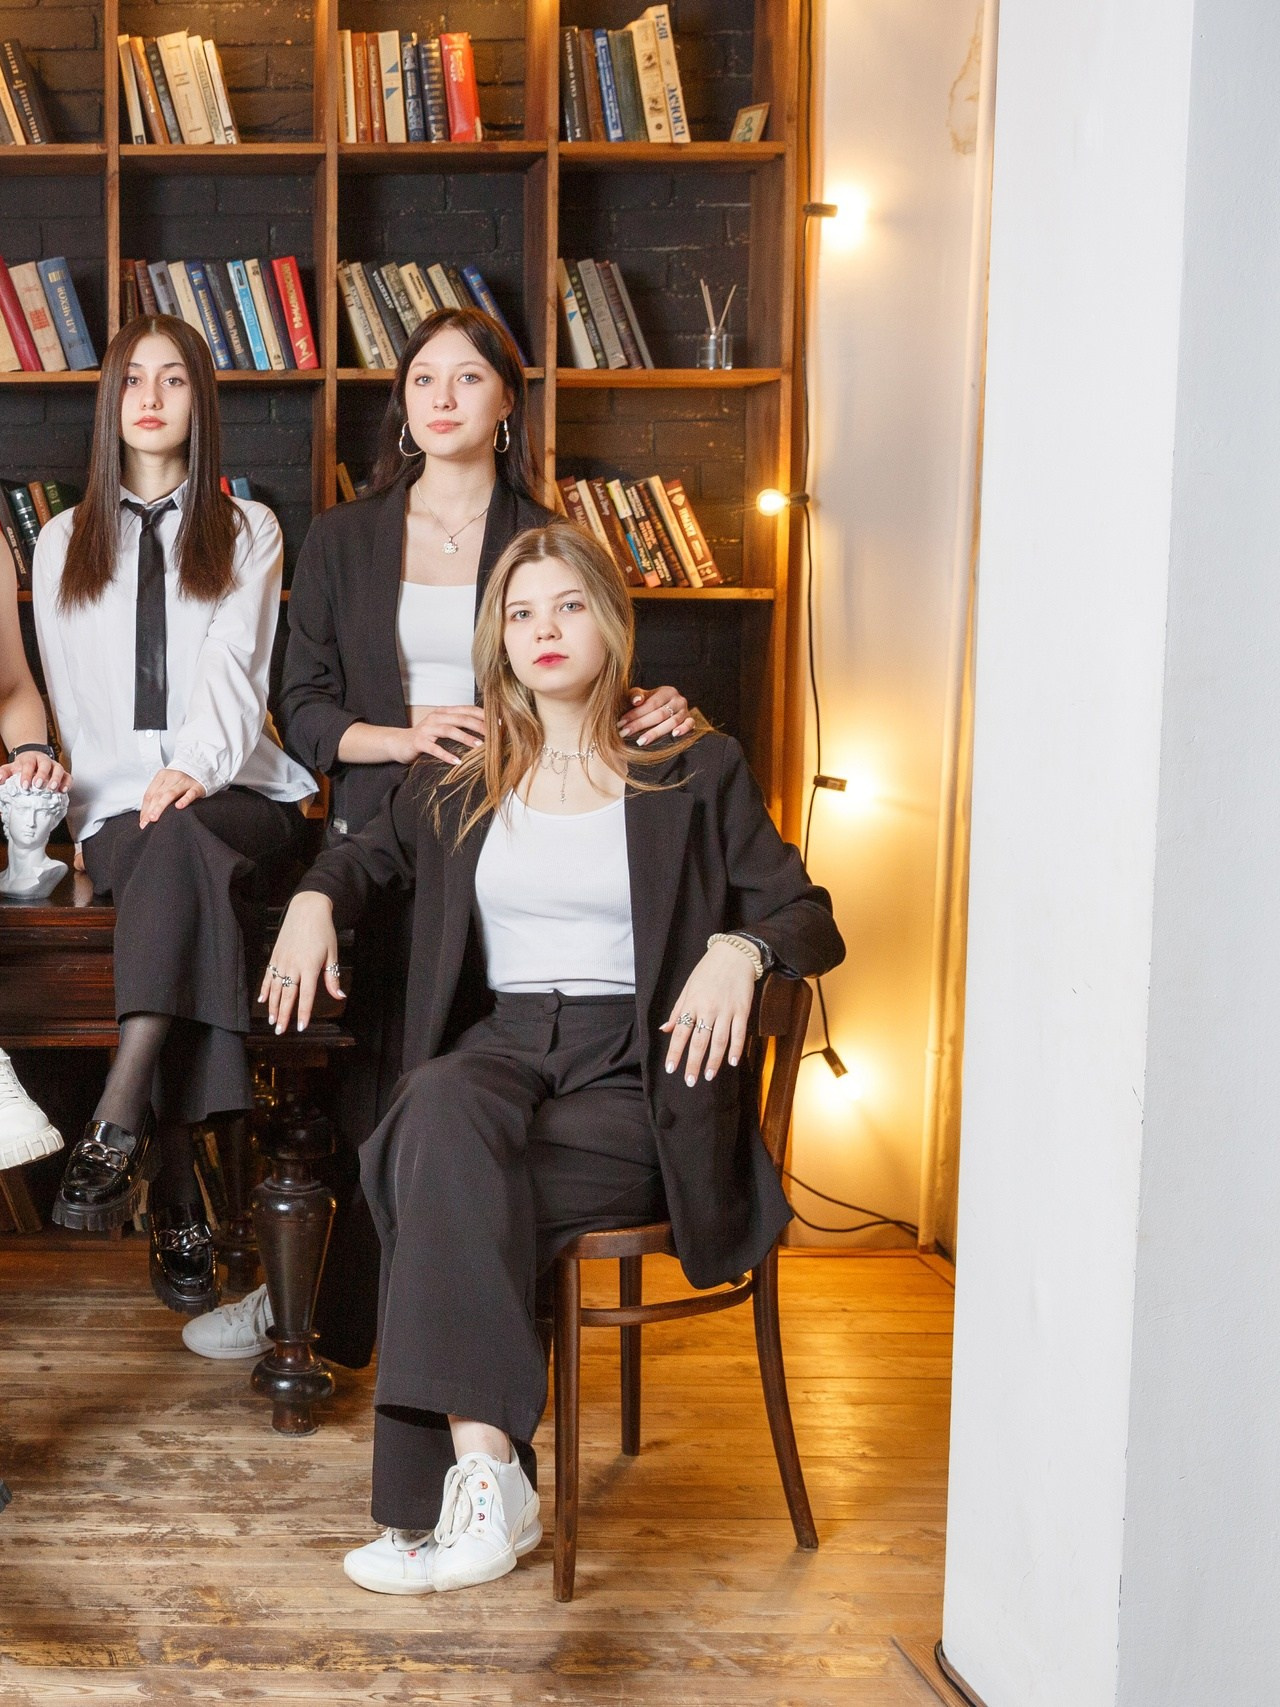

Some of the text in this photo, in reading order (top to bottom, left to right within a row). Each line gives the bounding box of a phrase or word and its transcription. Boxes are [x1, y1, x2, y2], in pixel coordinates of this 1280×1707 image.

[54, 285, 73, 316] ЧЕХОВ
[371, 268, 394, 310] ДЕТЕКТИВА
[223, 309, 237, 330] КОНЬ
[228, 328, 244, 354] РЫЖИЙ
